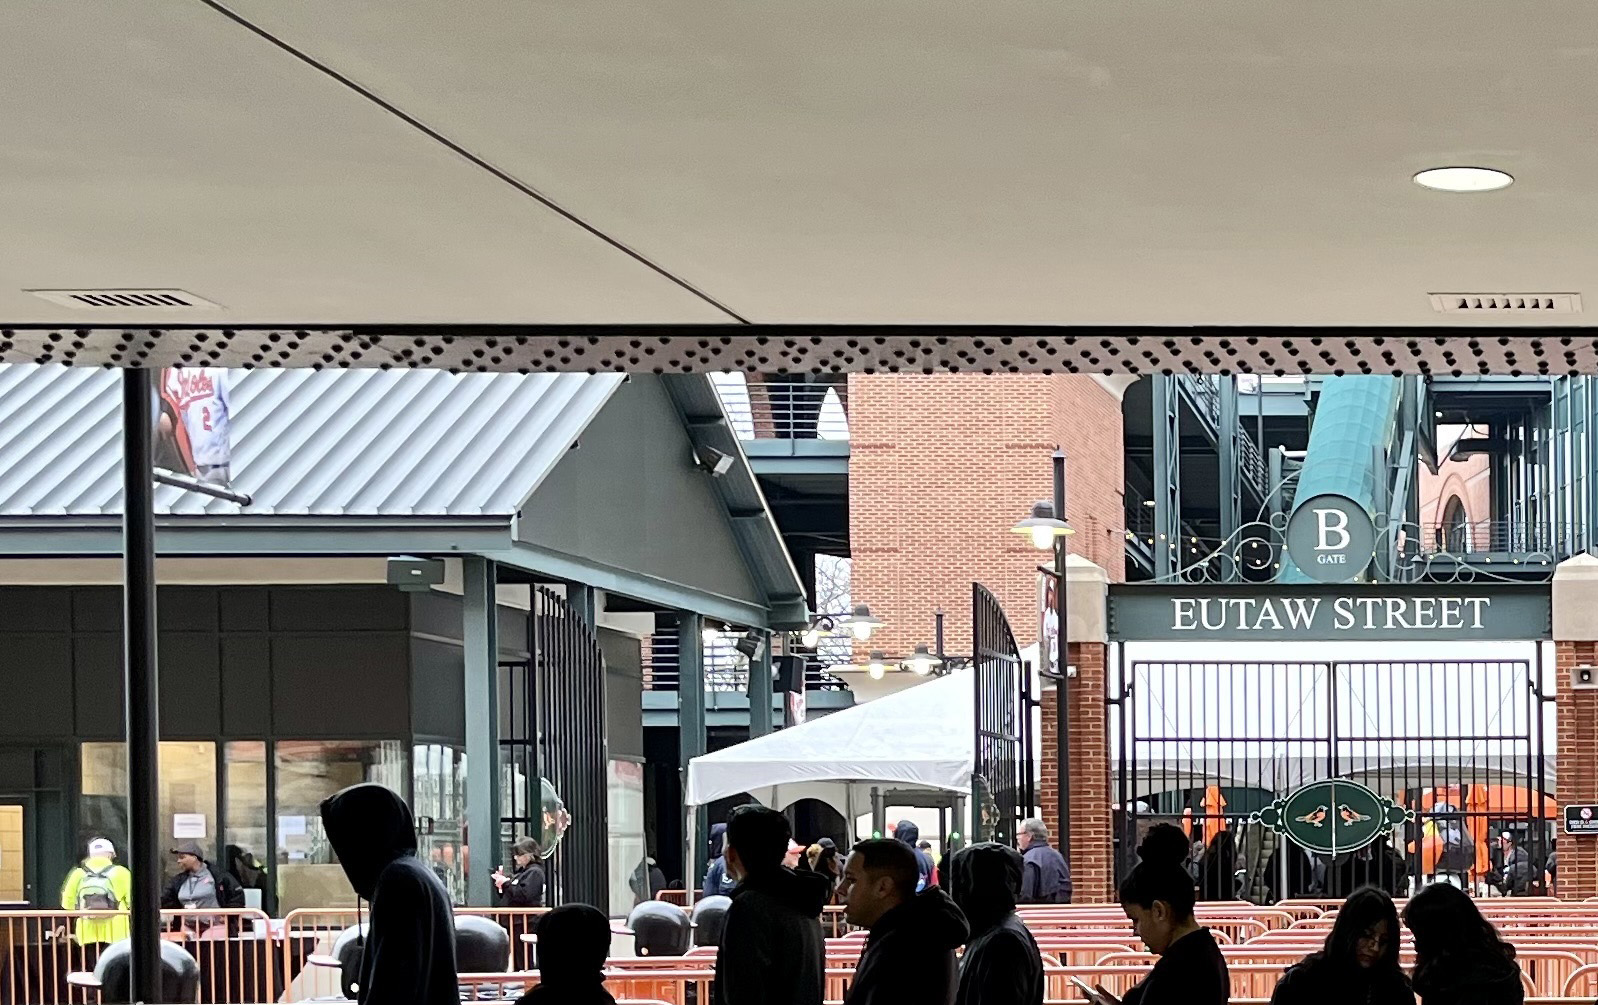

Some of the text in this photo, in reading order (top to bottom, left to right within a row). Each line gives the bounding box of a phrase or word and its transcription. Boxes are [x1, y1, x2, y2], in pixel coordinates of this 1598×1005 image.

[202, 406, 213, 432] 2
[1313, 508, 1351, 551] B
[1317, 554, 1346, 565] GATE
[1170, 597, 1491, 631] EUTAW STREET
